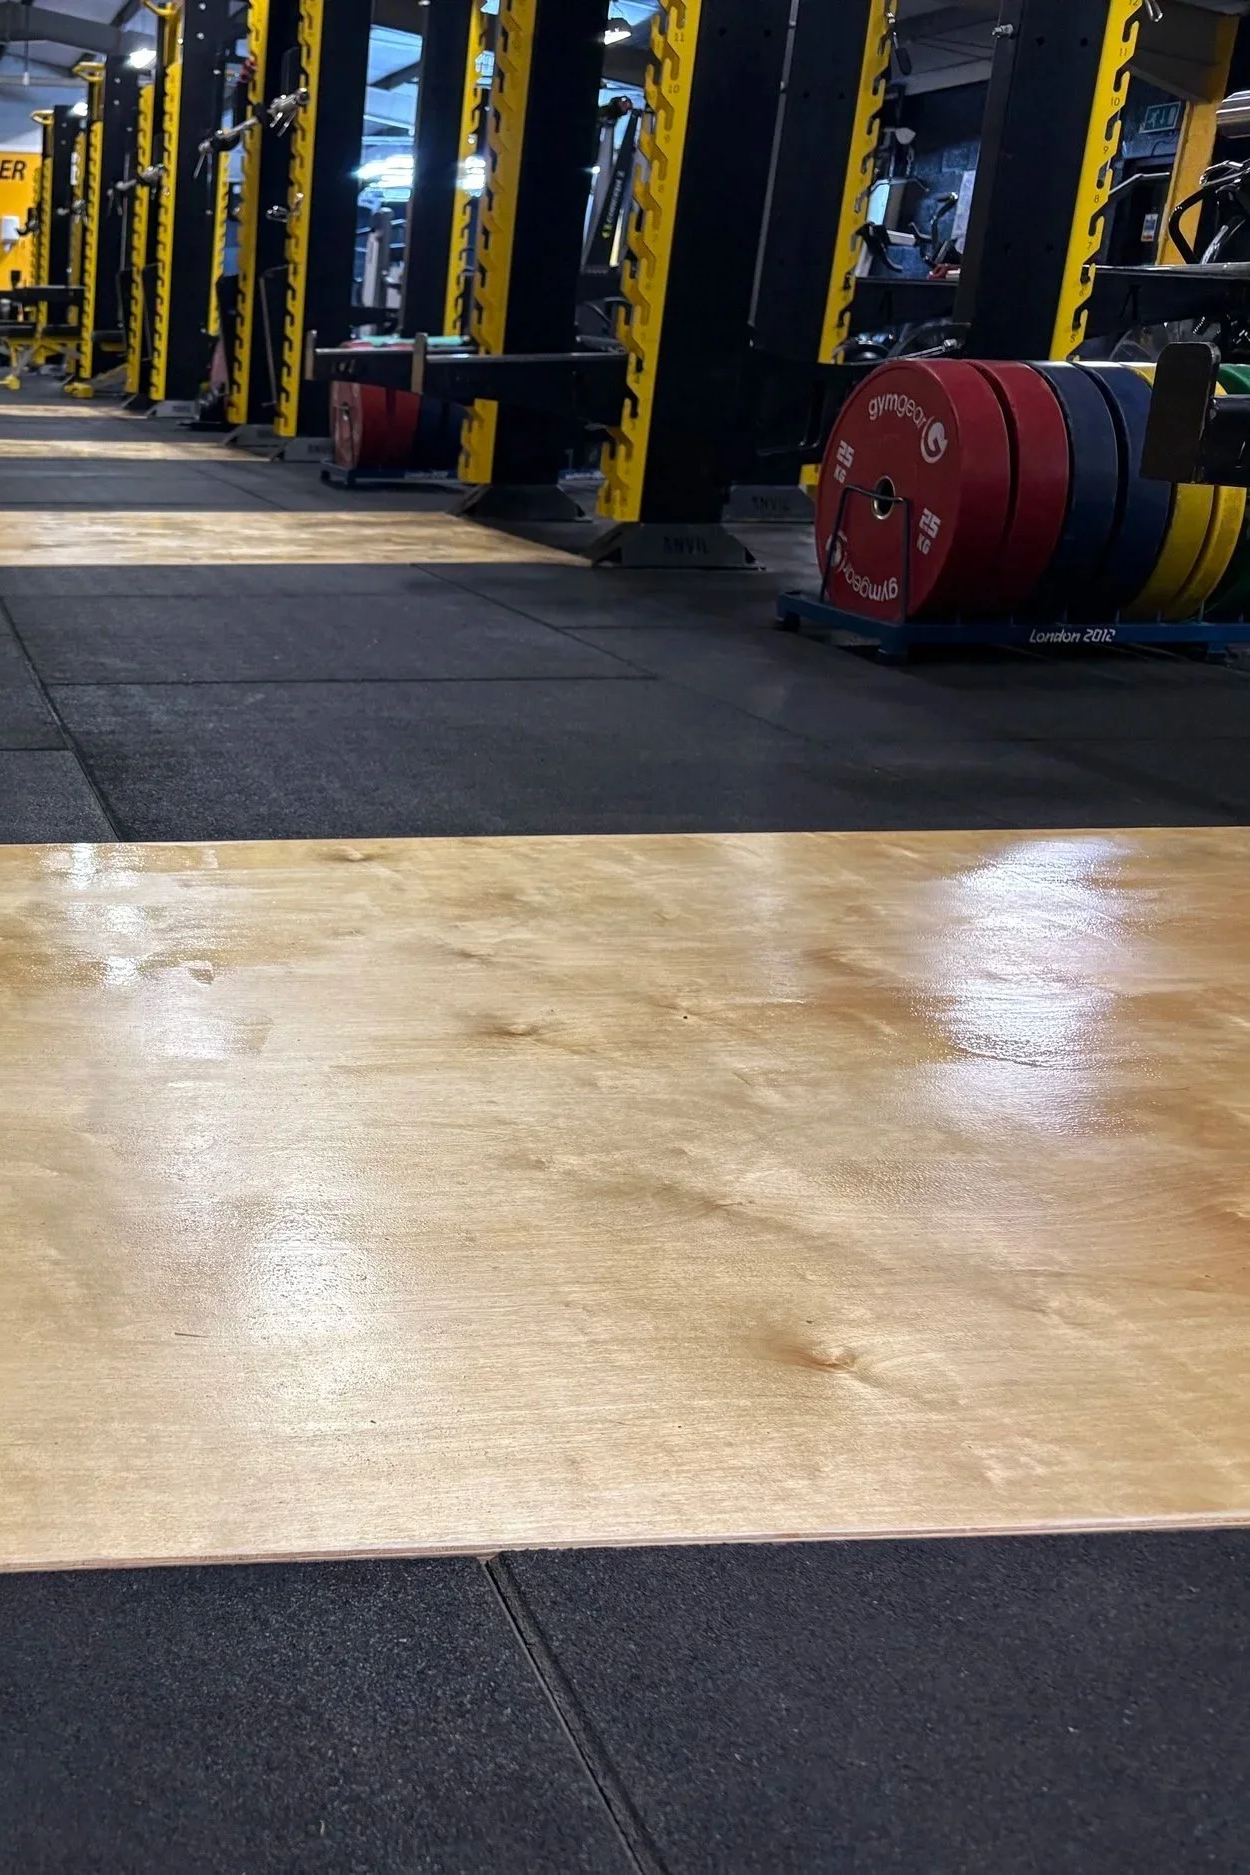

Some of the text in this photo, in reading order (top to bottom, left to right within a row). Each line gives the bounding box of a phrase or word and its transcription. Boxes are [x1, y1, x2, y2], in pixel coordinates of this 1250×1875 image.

[1110, 97, 1120, 107] 10
[1094, 195, 1100, 204] 8
[868, 394, 928, 430] gymgear
[836, 440, 855, 470] 25
[834, 465, 847, 484] KG
[919, 508, 942, 539] 25
[916, 531, 932, 554] KG
[839, 558, 898, 602] gymgear
[1029, 628, 1116, 643] London 2012
